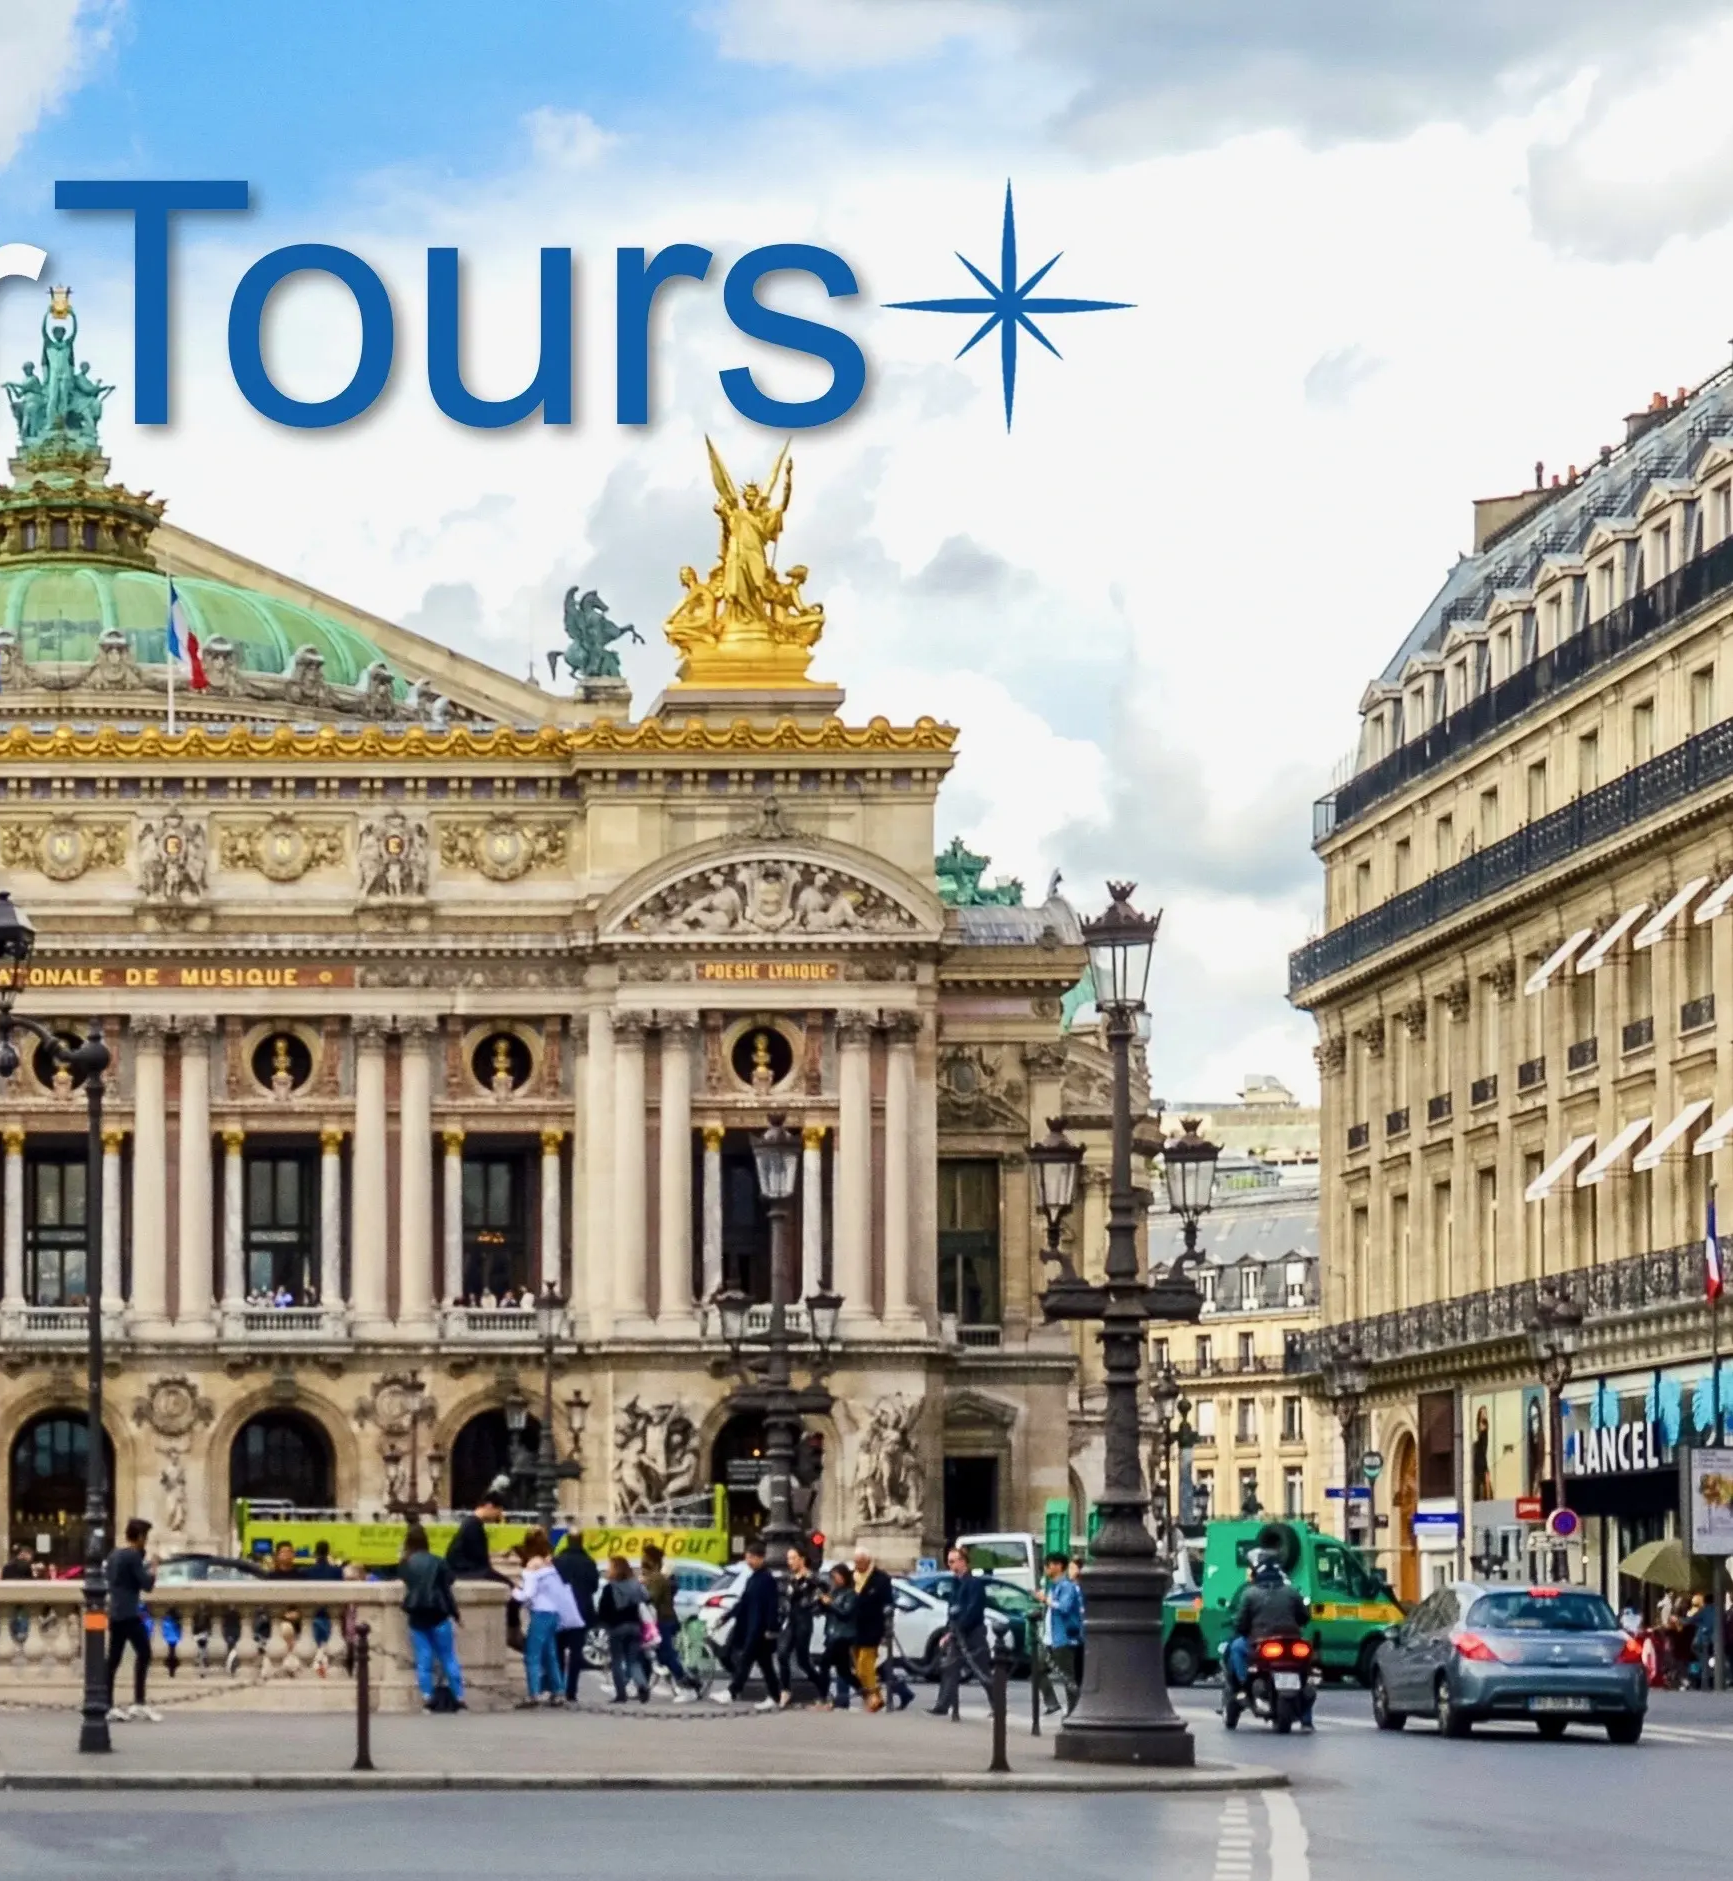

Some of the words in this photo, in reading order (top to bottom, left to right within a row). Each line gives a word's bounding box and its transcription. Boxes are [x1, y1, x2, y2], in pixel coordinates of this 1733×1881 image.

[125, 968, 159, 985] DE
[180, 968, 297, 985] MUSIQUE
[705, 963, 759, 979] POESIE
[1574, 1421, 1659, 1475] LANCEL
